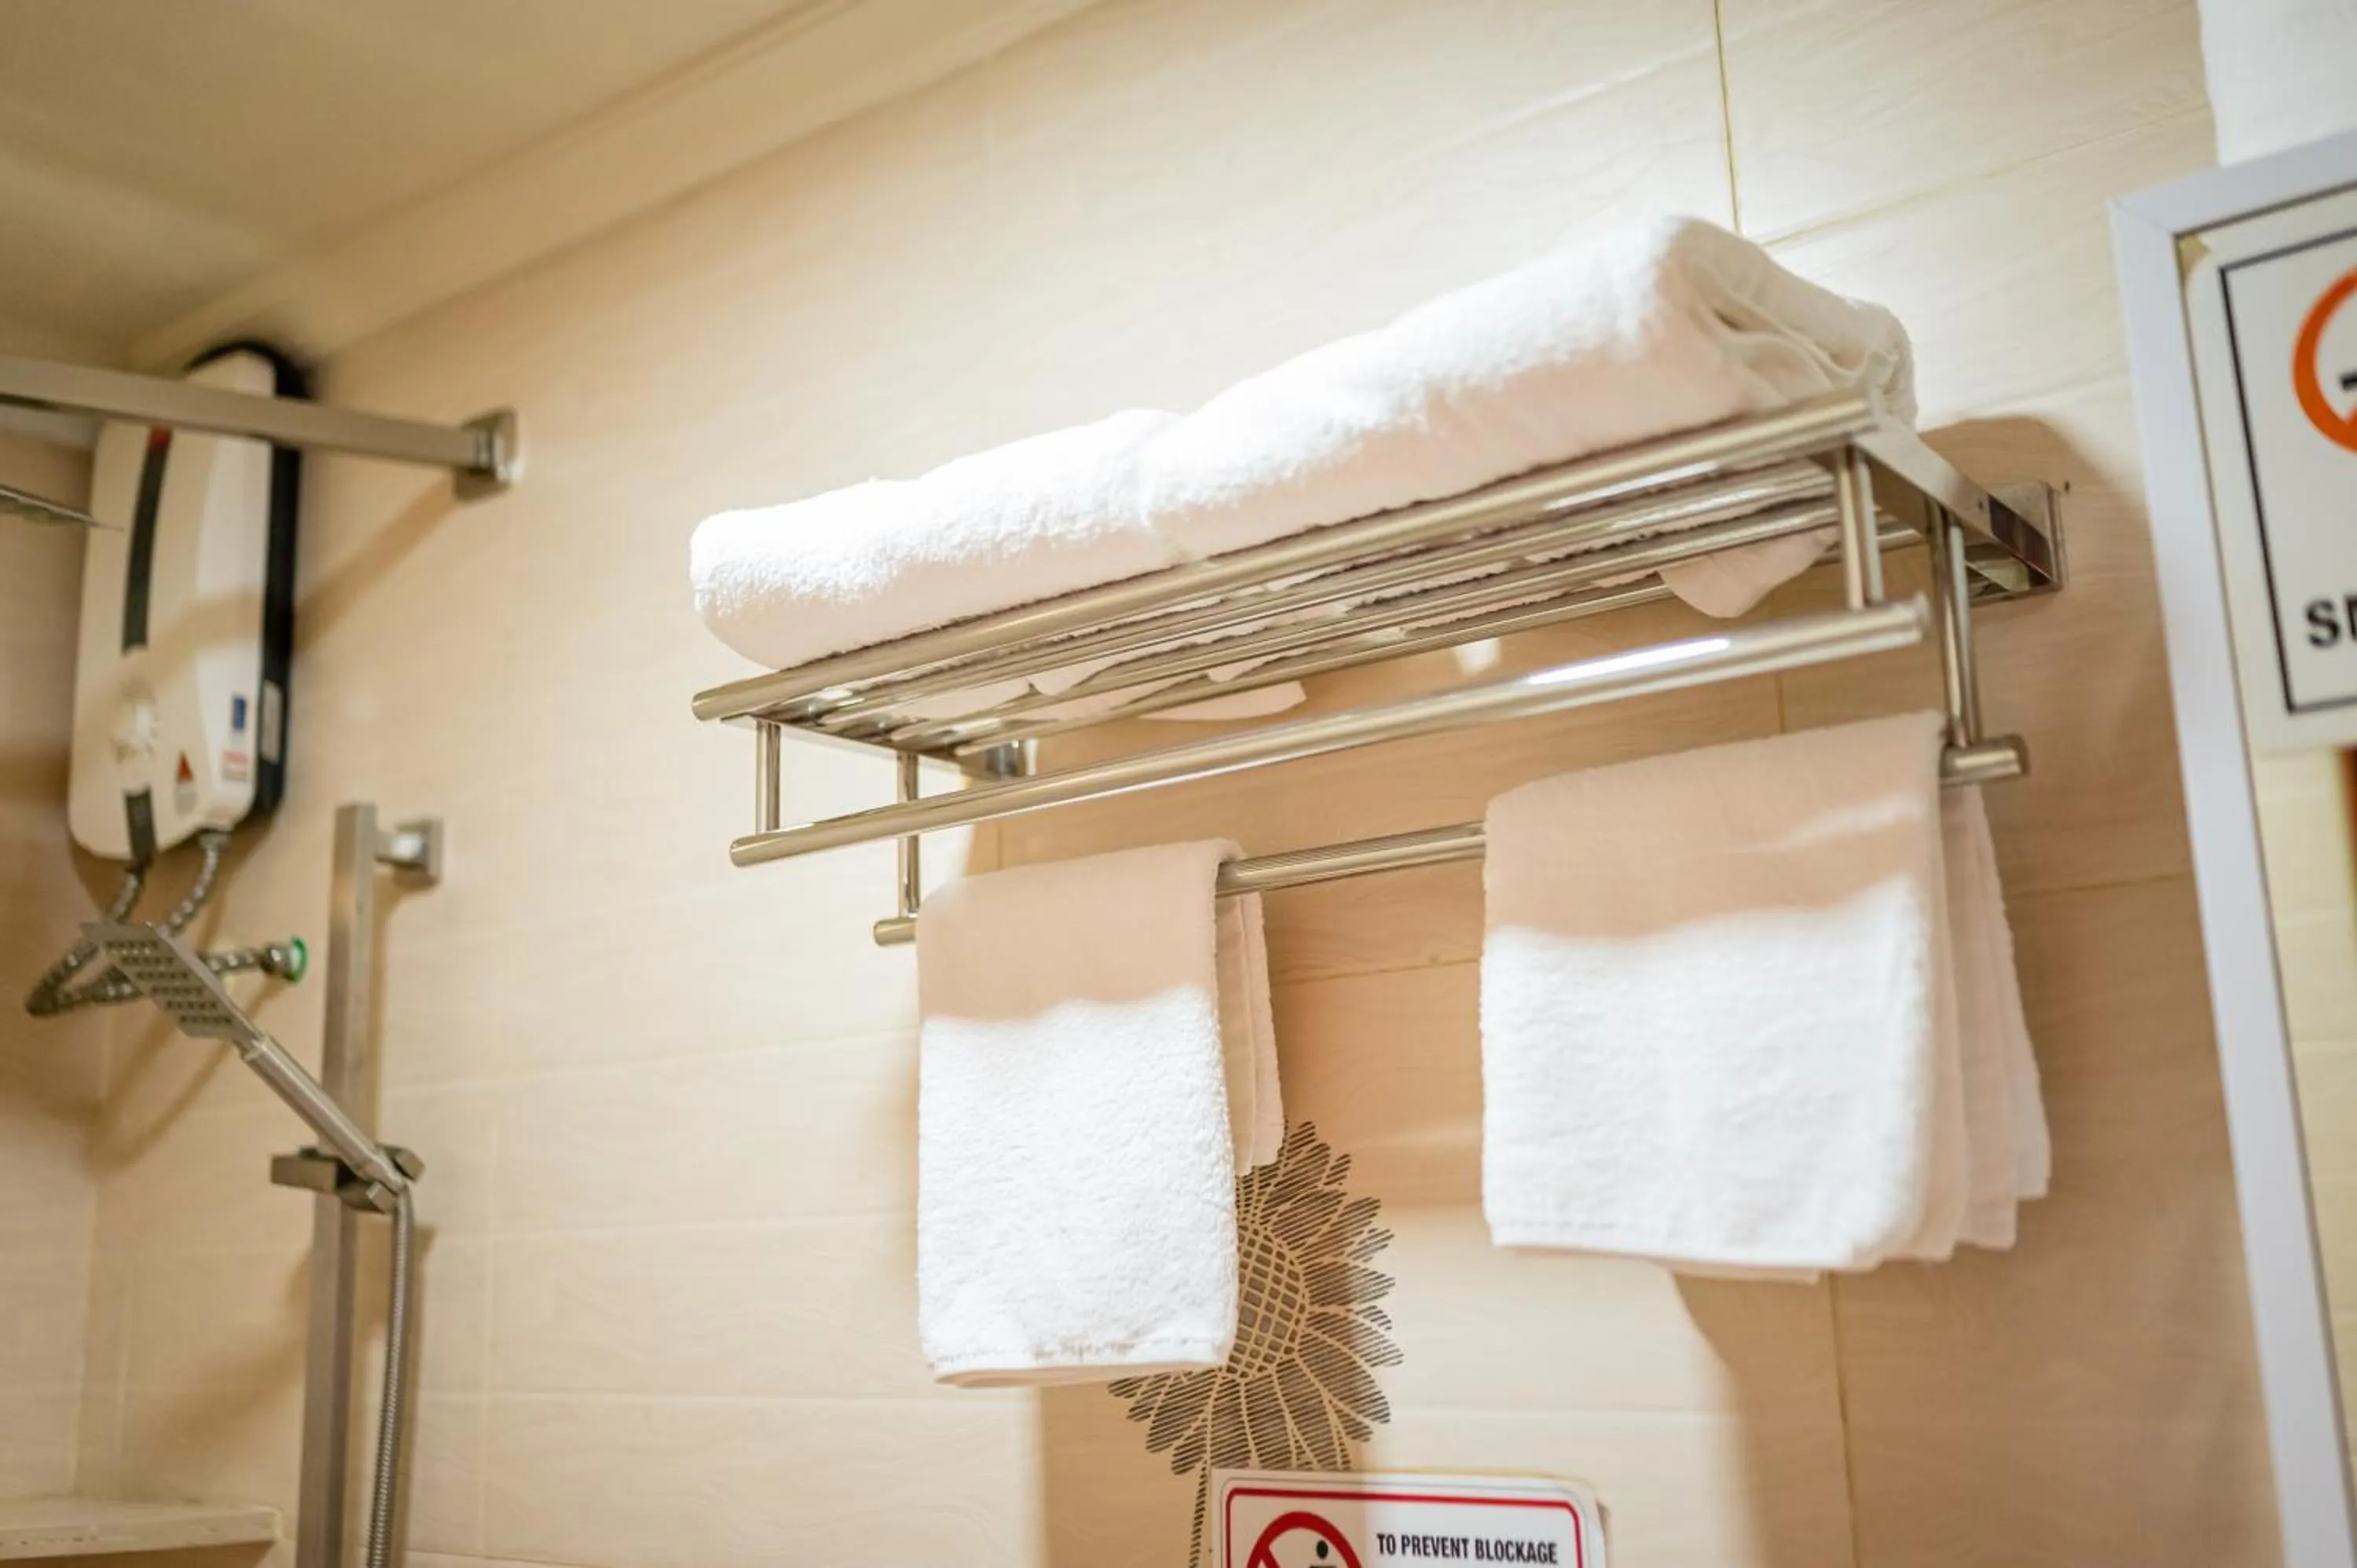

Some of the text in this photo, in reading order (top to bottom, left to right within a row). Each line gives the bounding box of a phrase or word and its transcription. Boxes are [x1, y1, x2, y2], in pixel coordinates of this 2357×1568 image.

[1376, 1533, 1557, 1564] TO PREVENT BLOCKAGE
